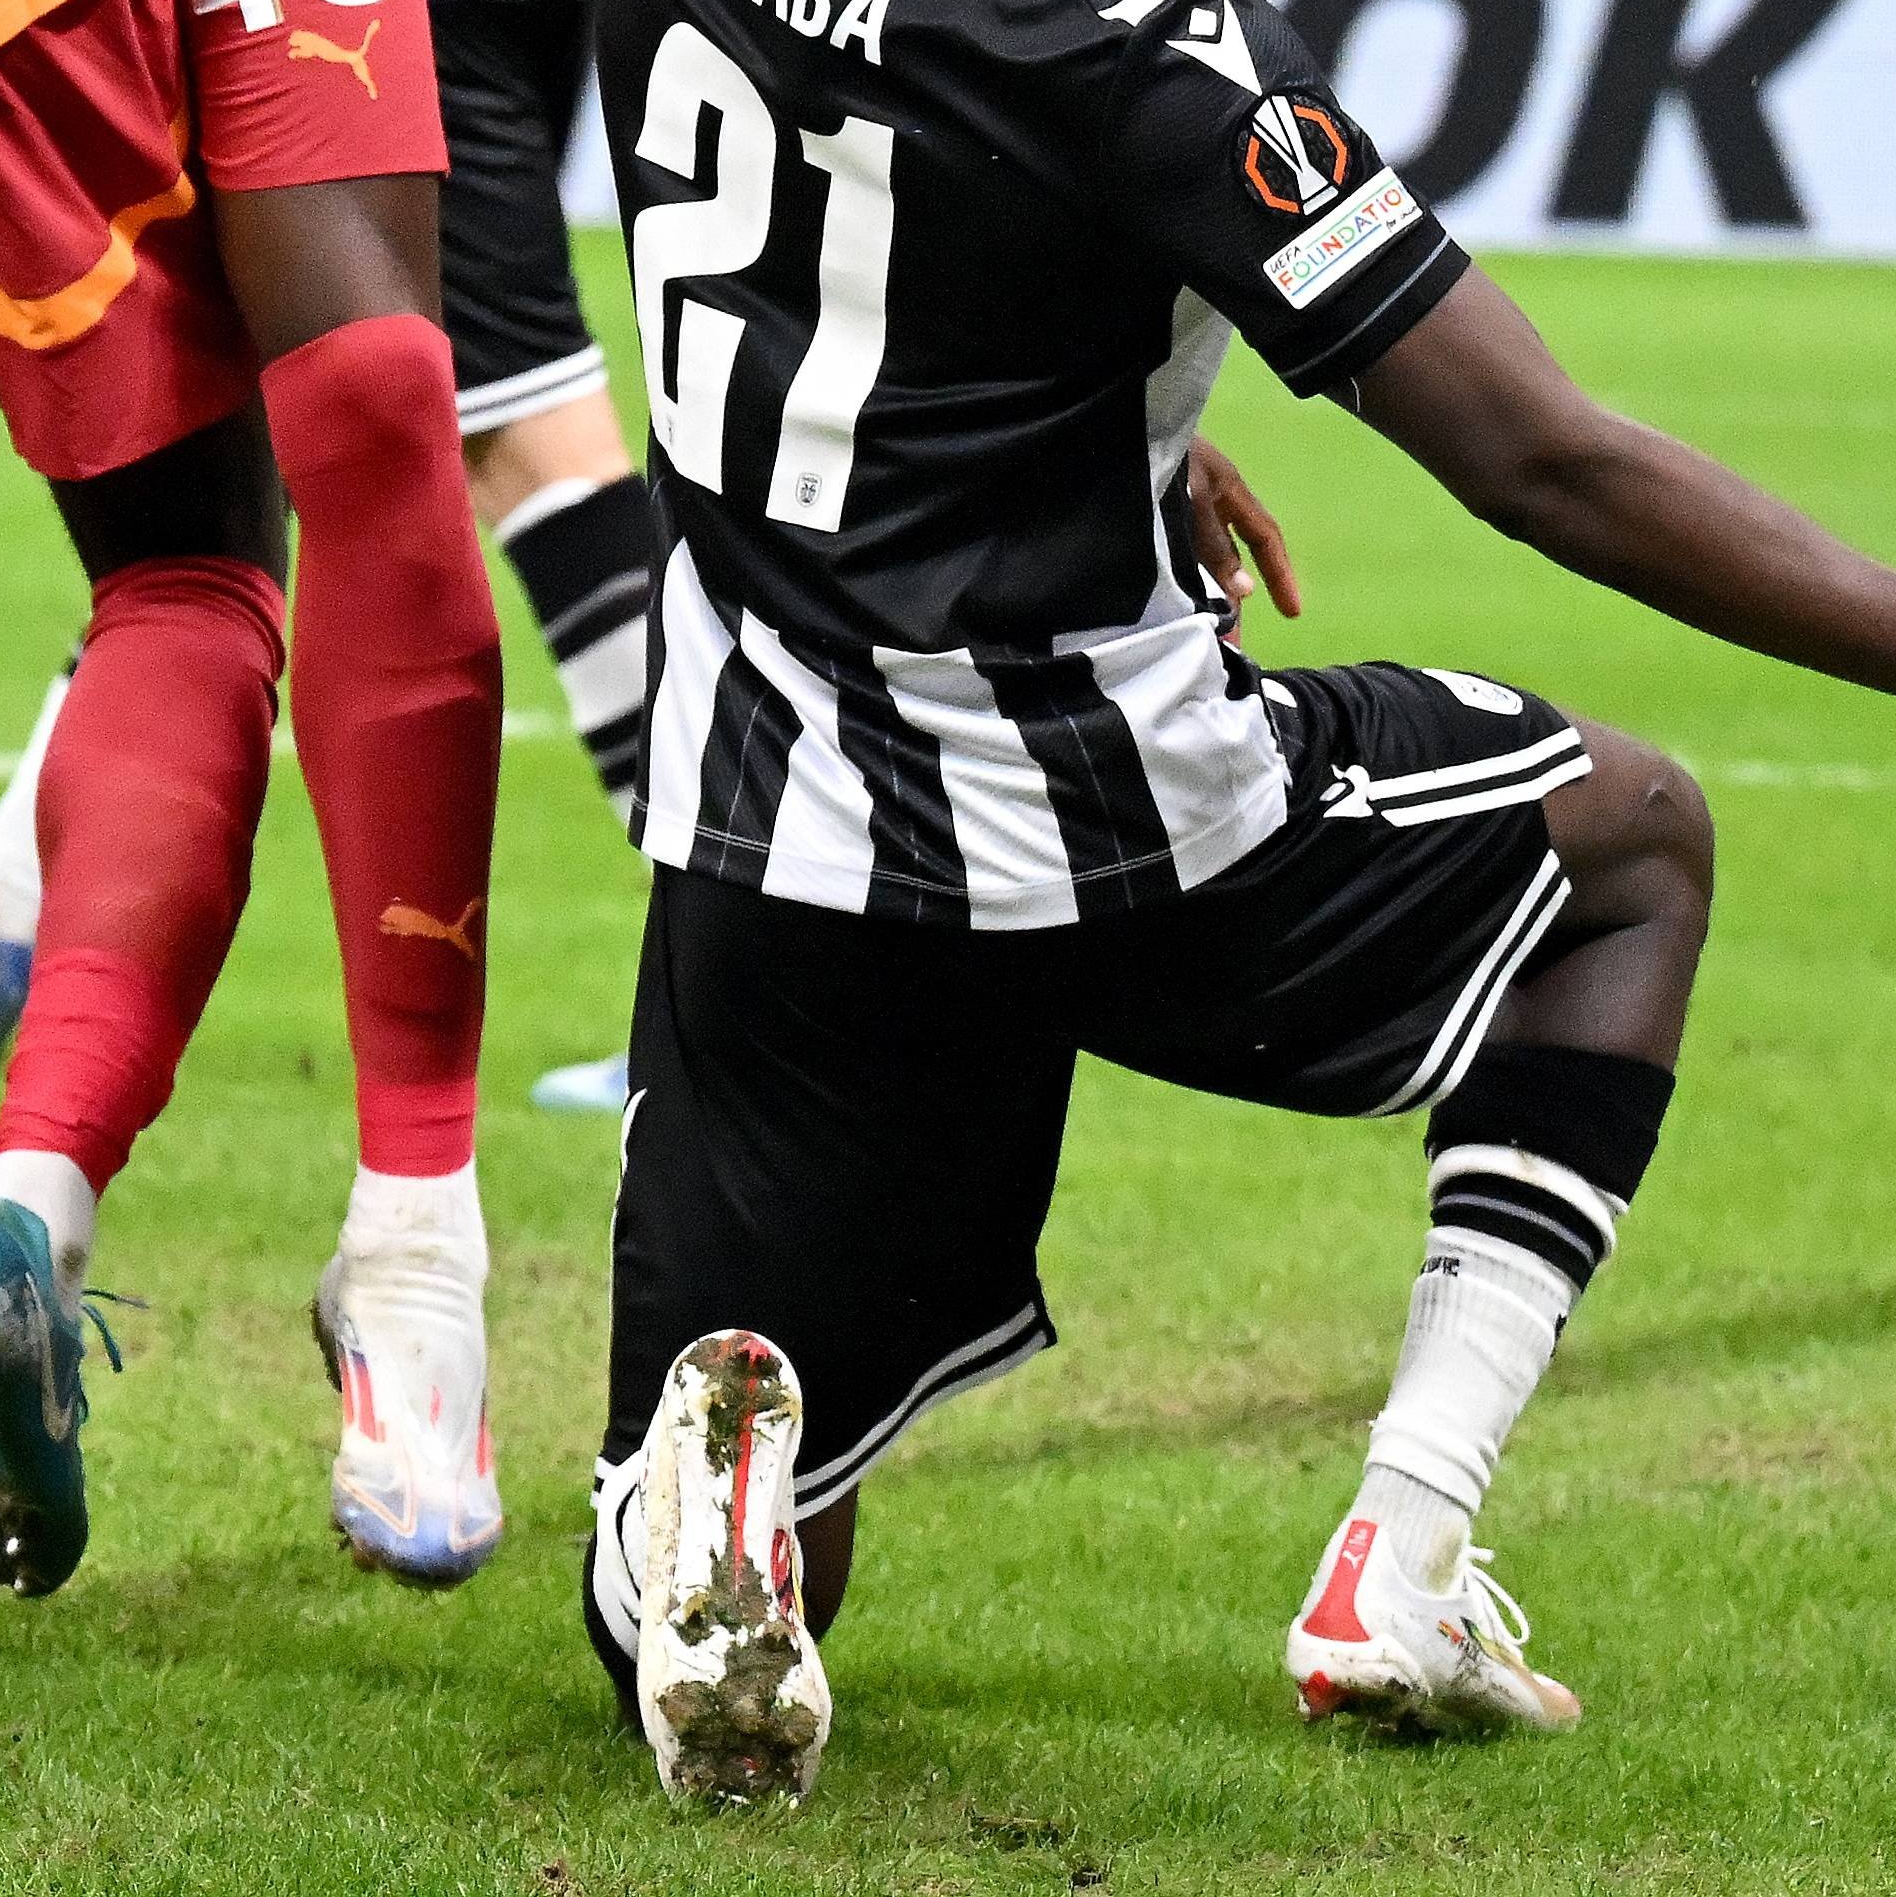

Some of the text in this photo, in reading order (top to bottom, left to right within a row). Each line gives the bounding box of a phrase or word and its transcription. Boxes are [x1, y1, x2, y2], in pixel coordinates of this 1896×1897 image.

[633, 21, 895, 534] 21
[1270, 245, 1302, 274] UEFA
[1278, 183, 1408, 291] FOUNDATIO
